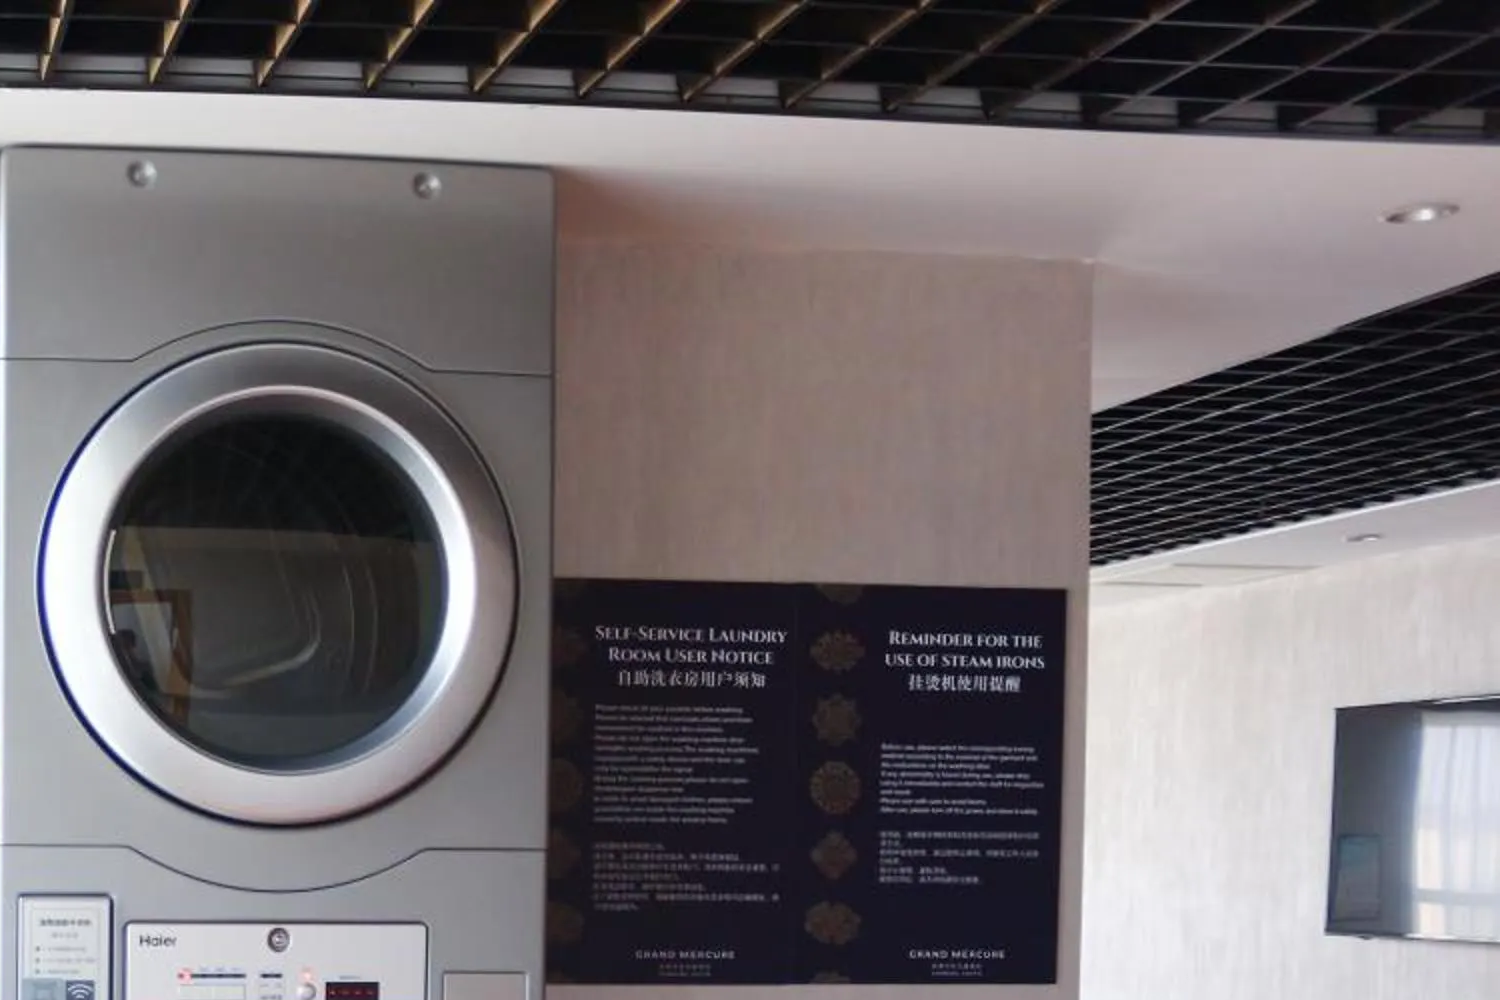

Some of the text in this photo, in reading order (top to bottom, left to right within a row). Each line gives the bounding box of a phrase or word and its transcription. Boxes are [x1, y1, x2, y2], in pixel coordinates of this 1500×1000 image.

[595, 625, 788, 644] SELF-SERVICE LAUNDRY
[889, 631, 1043, 649] REMINDER FOR THE
[608, 648, 775, 665] ROOM USER NOTICE
[885, 653, 1045, 669] USE OF STEAM IRONS
[618, 669, 766, 689] 自助洗衣房用户须知
[908, 673, 1021, 693] 挂烫机使用提醒
[138, 934, 178, 947] Haier
